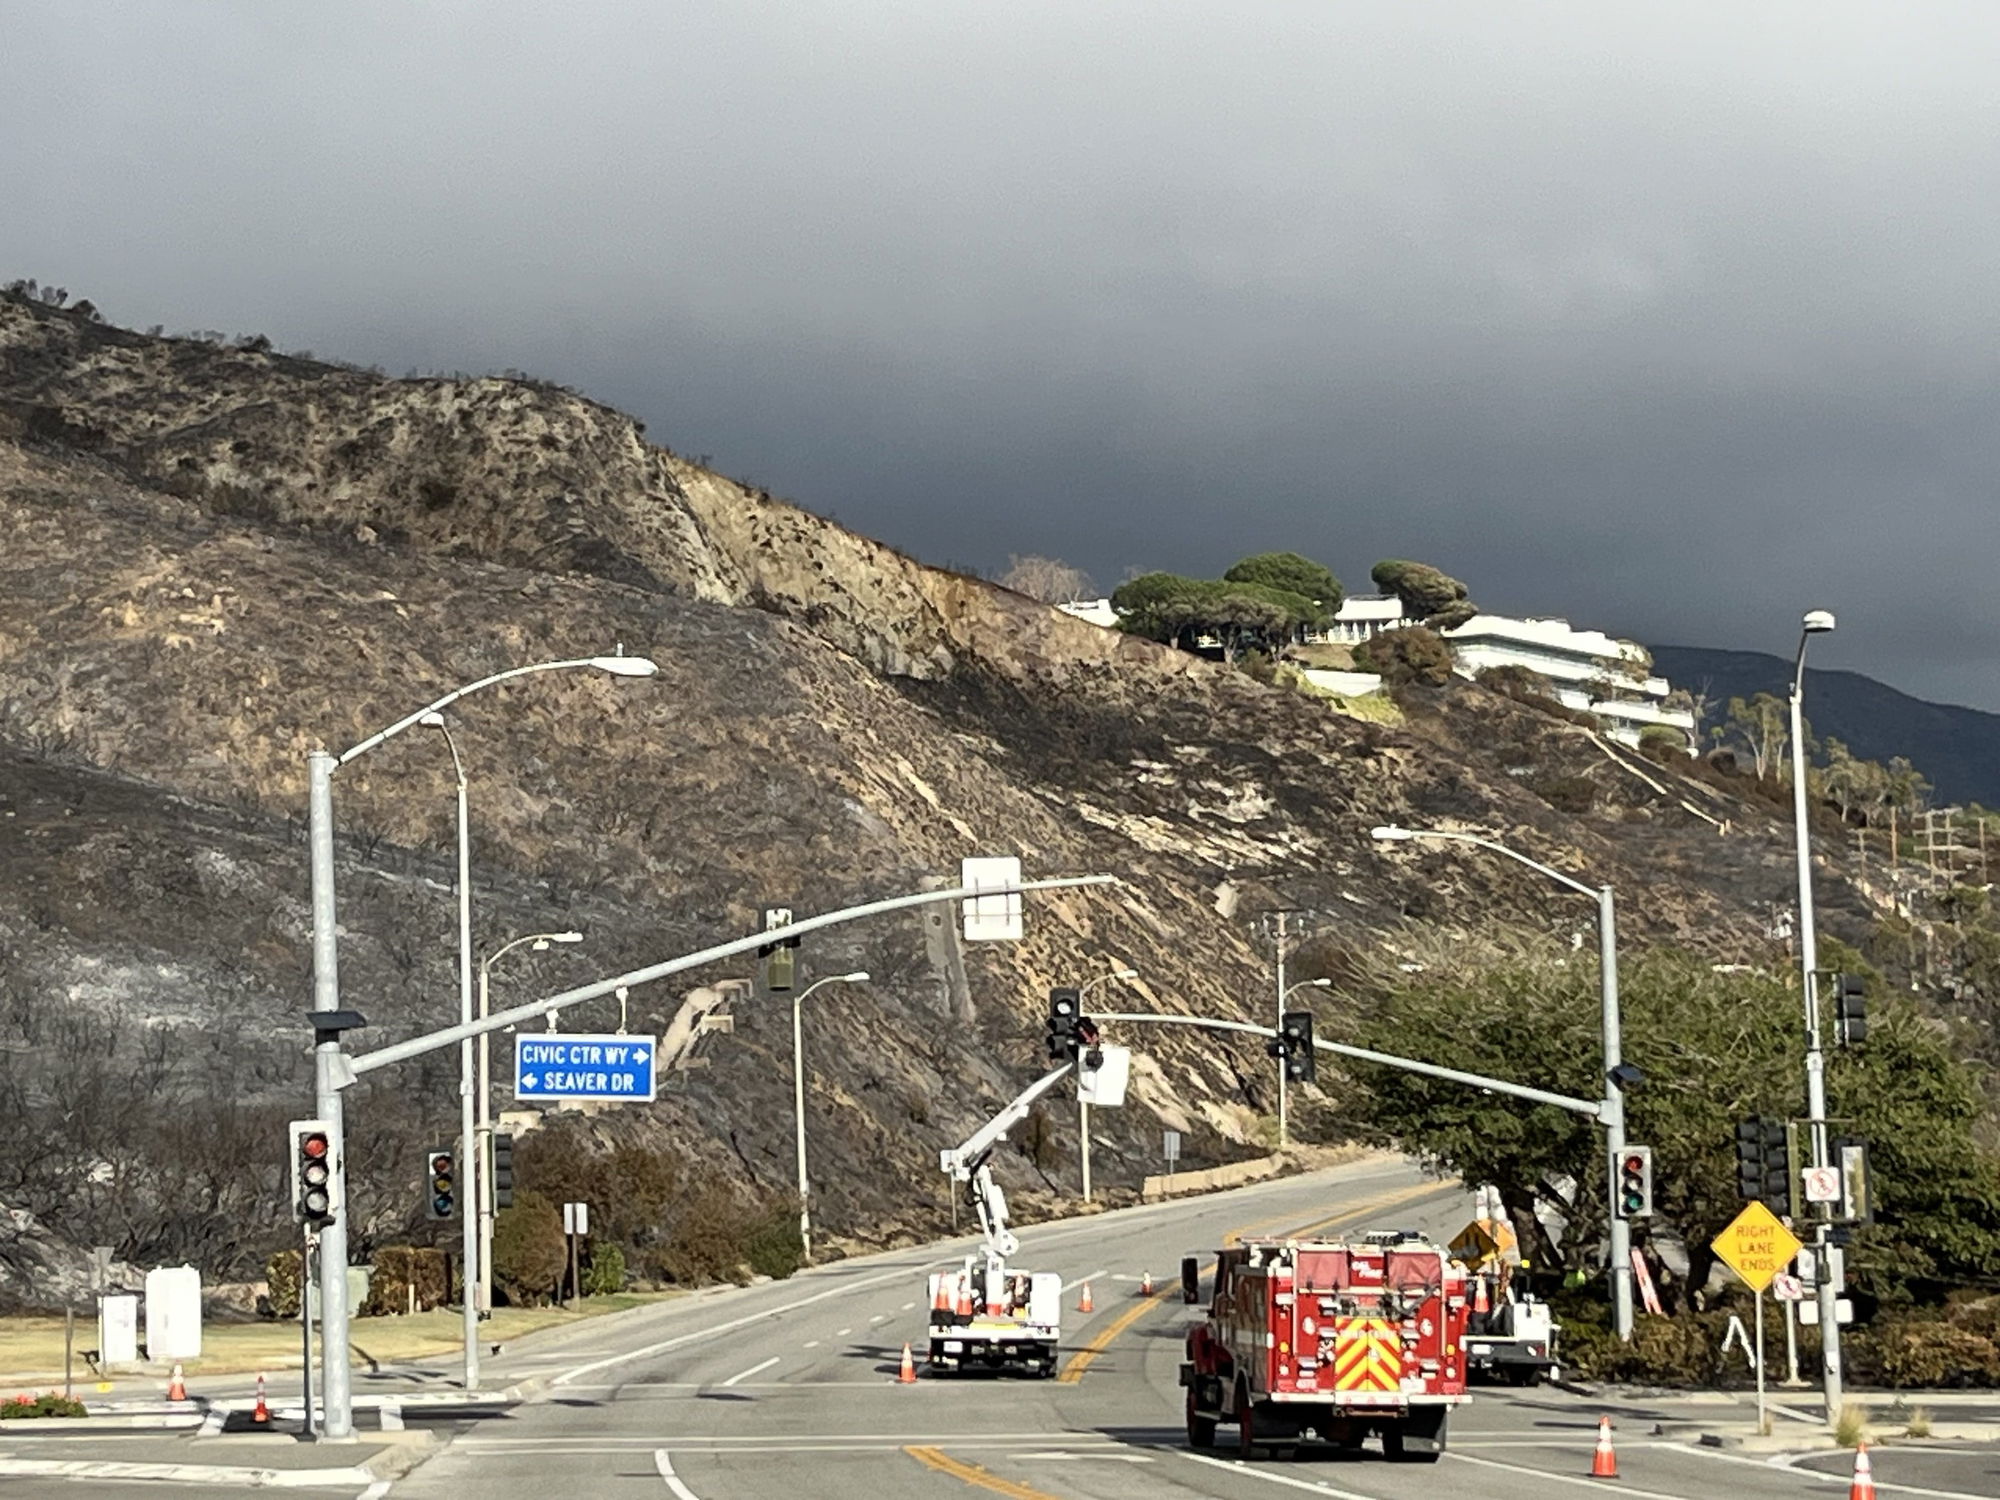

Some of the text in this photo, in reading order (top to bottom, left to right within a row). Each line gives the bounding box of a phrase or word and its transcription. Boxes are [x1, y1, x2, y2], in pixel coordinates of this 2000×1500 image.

[522, 1046, 629, 1065] CIVIC CTR WY
[544, 1072, 634, 1091] SEAVER DR
[1736, 1225, 1775, 1238] RIGHT
[1738, 1242, 1775, 1254] LANE
[1740, 1258, 1776, 1271] ENDS
